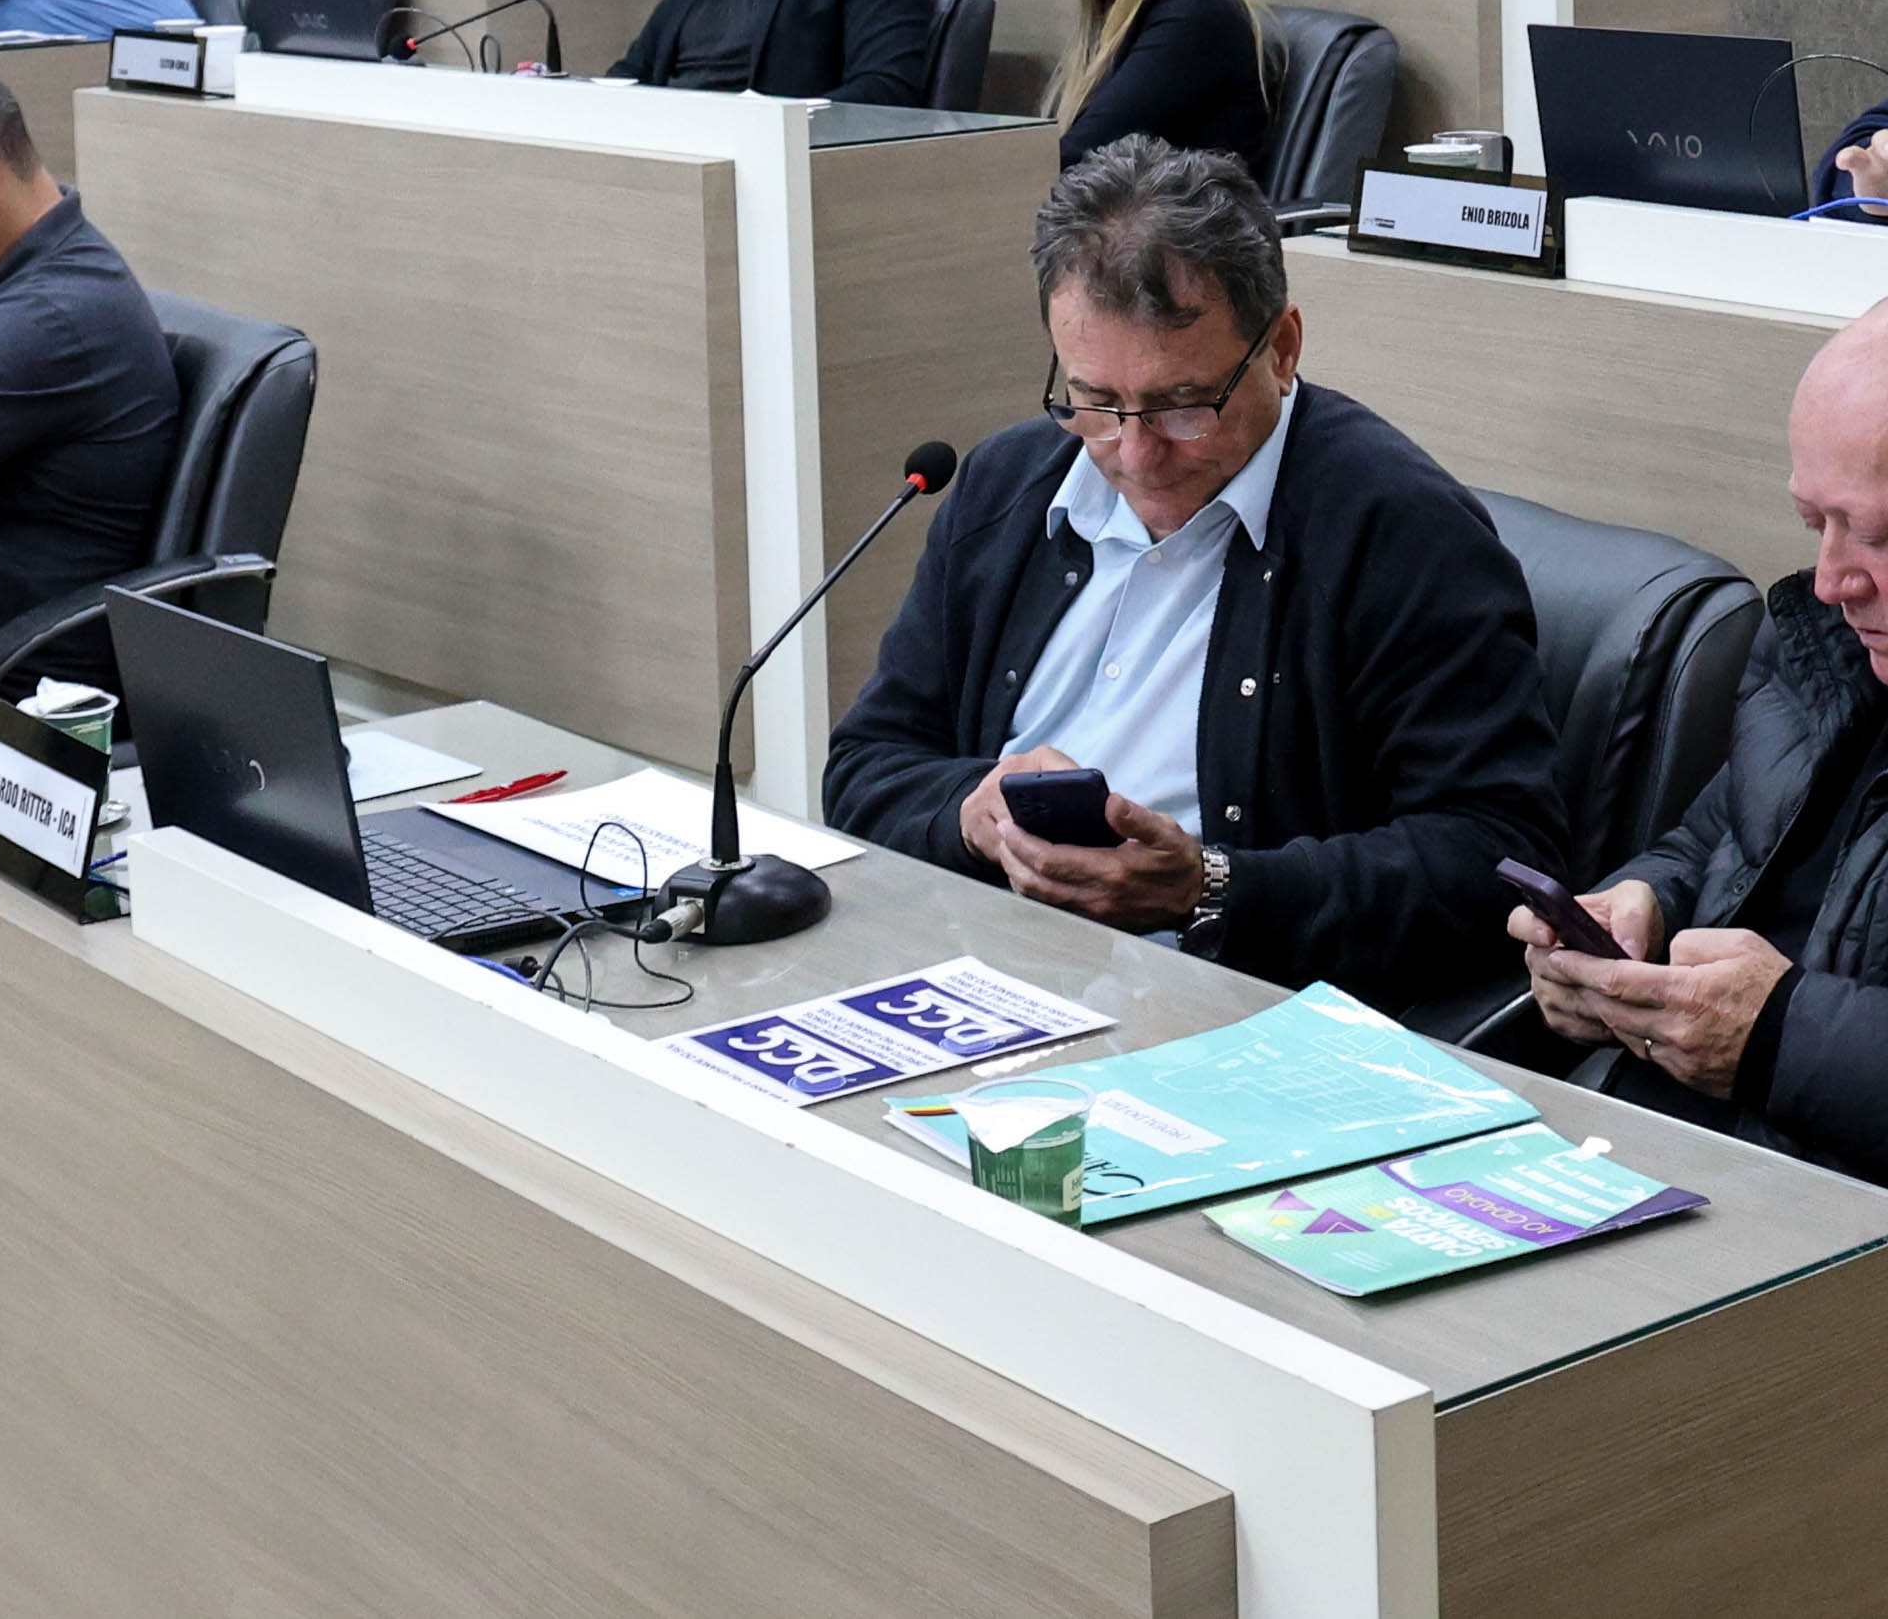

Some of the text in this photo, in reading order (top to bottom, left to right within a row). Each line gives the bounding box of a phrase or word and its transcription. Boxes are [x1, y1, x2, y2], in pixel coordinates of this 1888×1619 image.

[1461, 205, 1530, 230] ENIO BRIZOLA
[18, 787, 53, 828] RITTER
[57, 808, 77, 841] ICA
[876, 991, 1004, 1044] DCC
[728, 1027, 864, 1084] DCC
[1380, 1217, 1485, 1257] CARTA
[1383, 1196, 1516, 1250] SERVIÇOS
[1443, 1188, 1561, 1236] AO CIDADÃO
